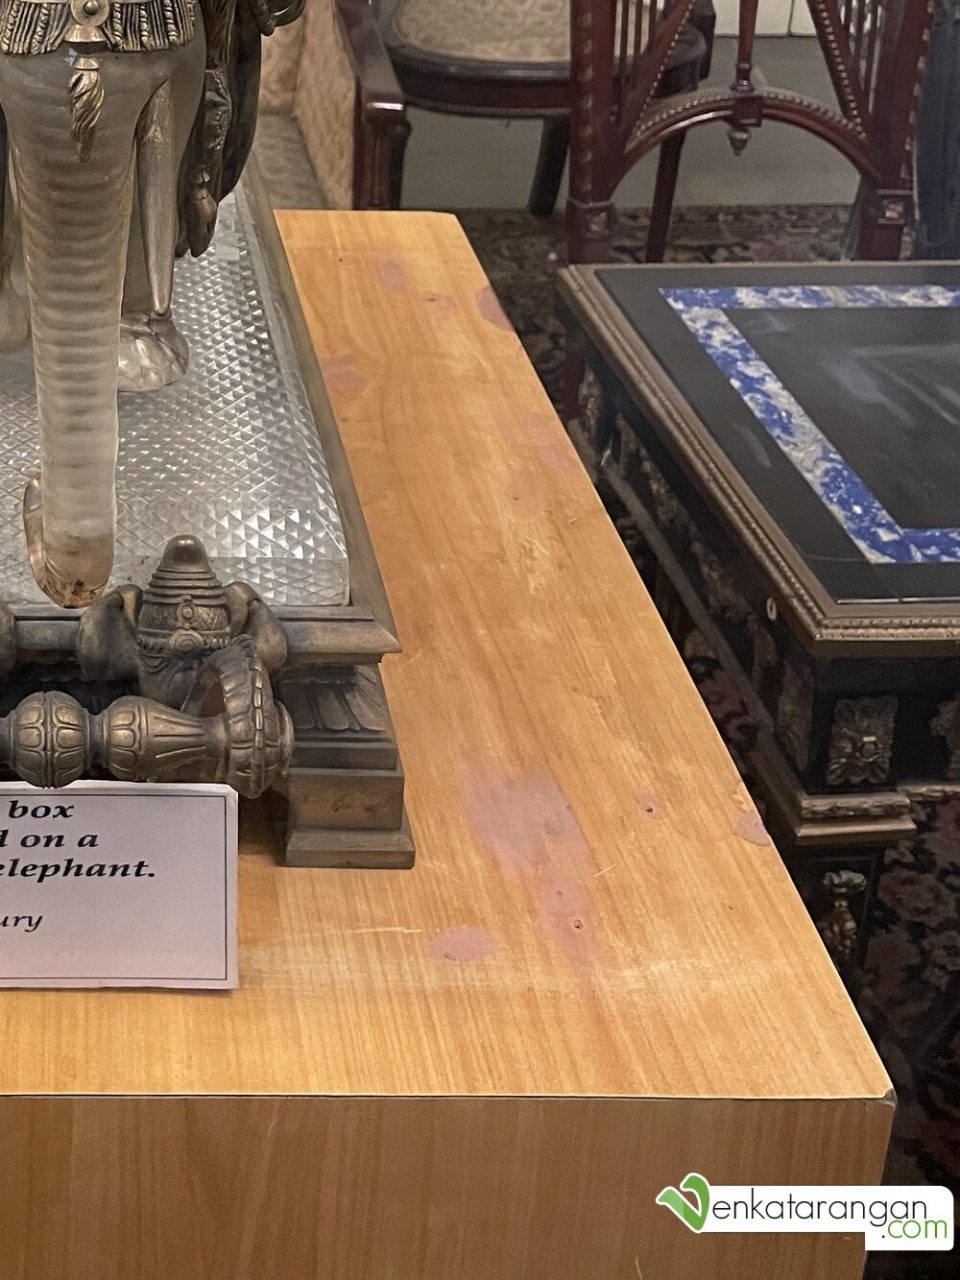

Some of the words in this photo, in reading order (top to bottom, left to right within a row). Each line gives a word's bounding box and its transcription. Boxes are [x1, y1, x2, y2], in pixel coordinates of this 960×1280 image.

[8, 800, 75, 819] box
[20, 833, 66, 849] on
[77, 832, 99, 849] a
